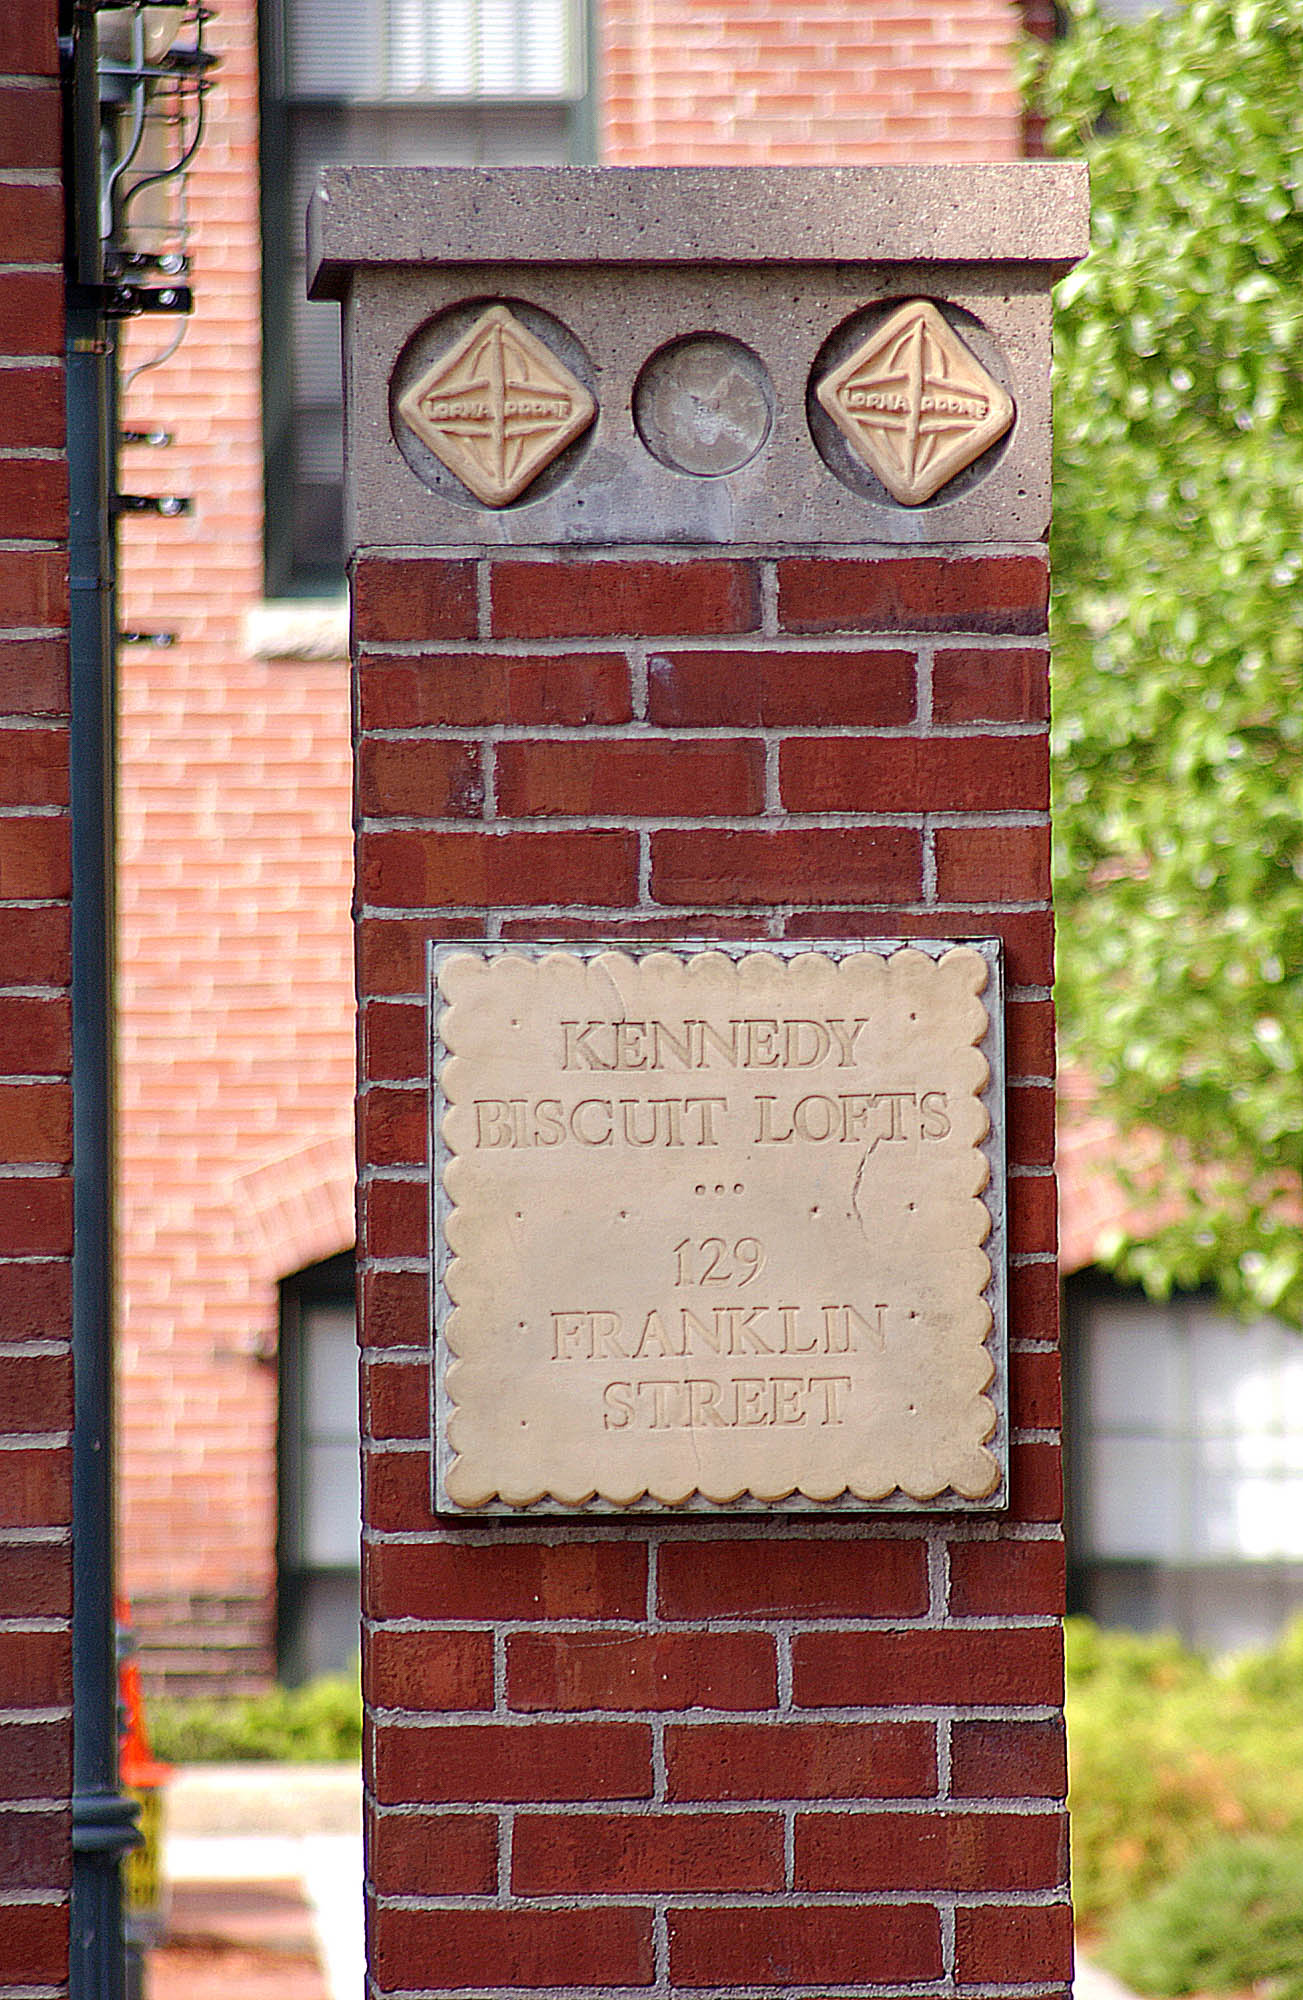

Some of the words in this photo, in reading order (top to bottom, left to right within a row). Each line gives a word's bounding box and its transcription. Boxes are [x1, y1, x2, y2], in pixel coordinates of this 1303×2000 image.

[560, 1018, 869, 1072] KENNEDY
[473, 1097, 728, 1149] BISCUIT
[754, 1091, 952, 1145] LOFTS
[673, 1237, 767, 1288] 129
[550, 1304, 889, 1361] FRANKLIN
[602, 1376, 852, 1431] STREET
